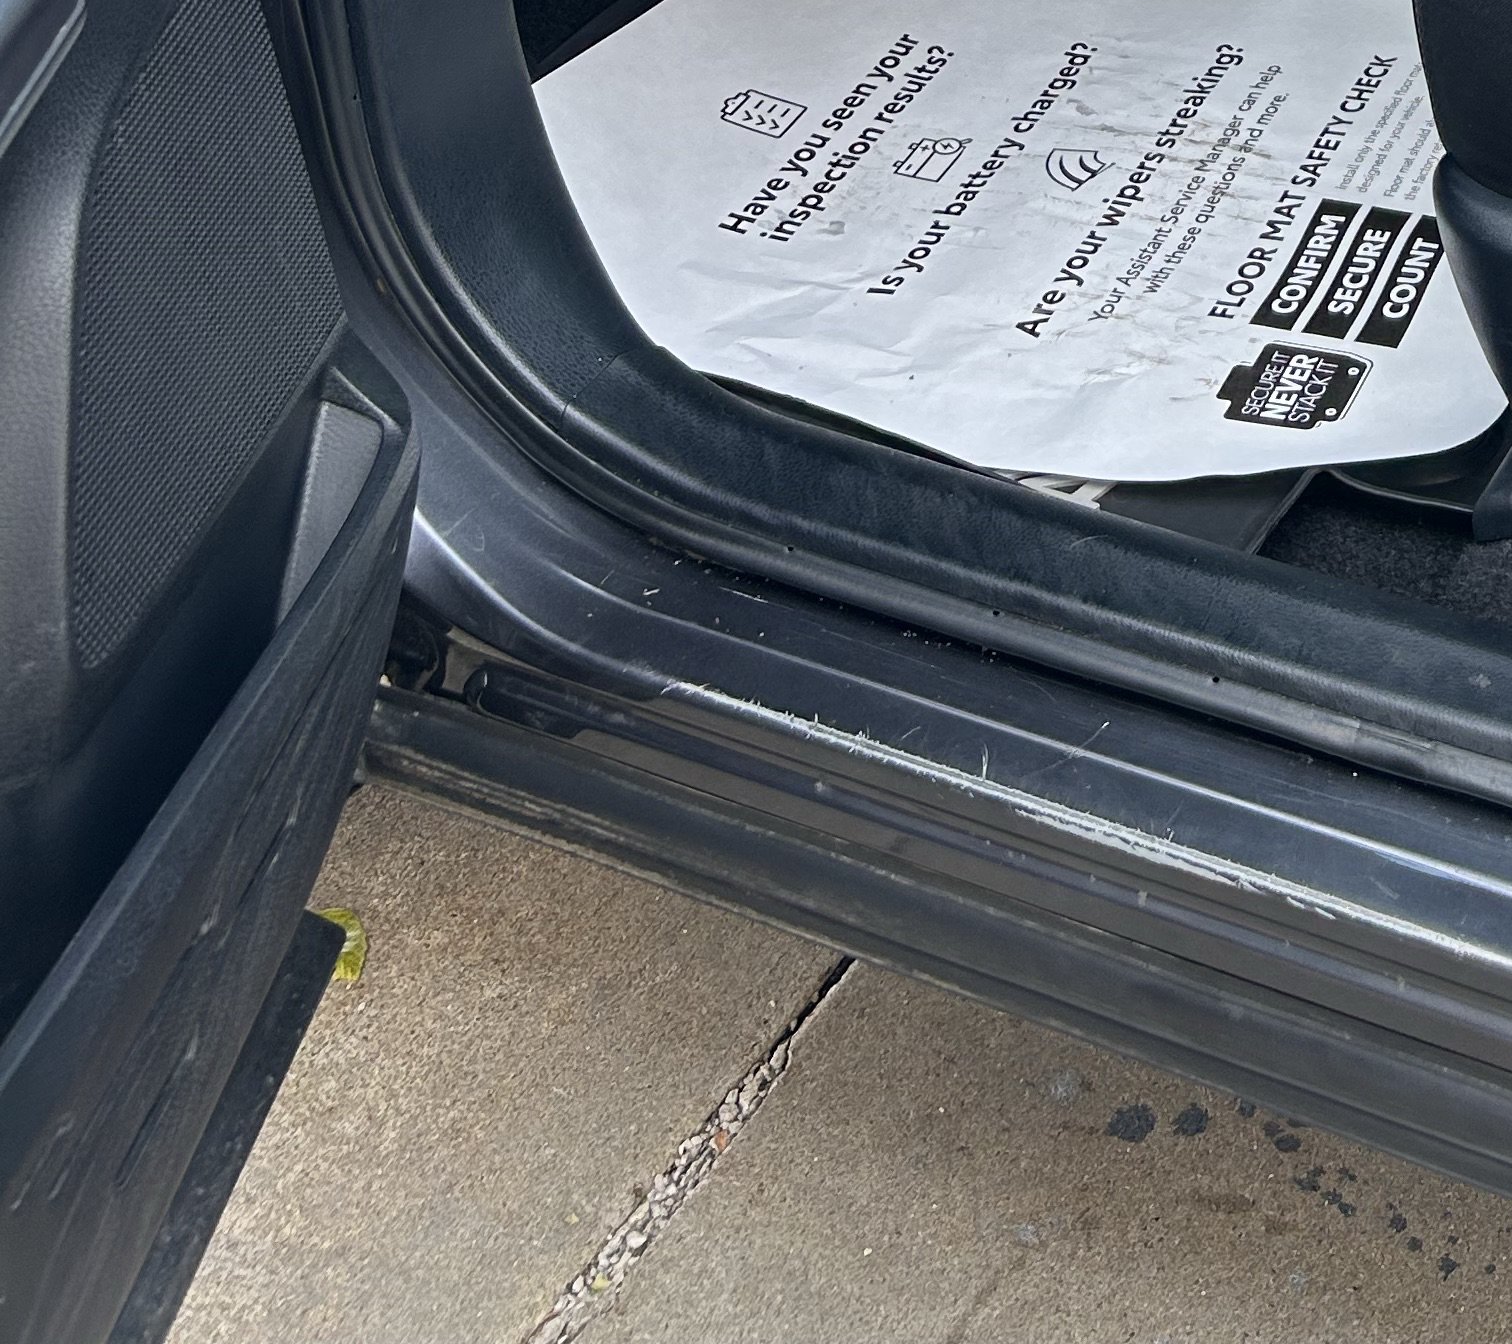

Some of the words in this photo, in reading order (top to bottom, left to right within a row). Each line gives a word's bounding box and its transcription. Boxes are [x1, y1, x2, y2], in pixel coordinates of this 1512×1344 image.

[1239, 91, 1262, 112] can
[1249, 64, 1283, 90] help
[718, 177, 791, 235] Have
[779, 133, 831, 178] you
[822, 81, 878, 132] seen
[866, 33, 920, 83] your
[759, 127, 886, 242] inspection
[874, 44, 955, 124] results?
[866, 274, 905, 296] Is
[894, 219, 951, 273] your
[932, 137, 1025, 216] battery
[1010, 42, 1099, 133] charged?
[1194, 114, 1244, 172] Manager
[1015, 288, 1067, 339] Are
[1054, 229, 1108, 288] your
[1096, 149, 1165, 227] wipers
[1155, 43, 1244, 149] streaking?
[1143, 267, 1175, 293] with
[1164, 226, 1201, 264] these
[1195, 156, 1246, 224] questions
[1238, 127, 1264, 153] and
[1256, 92, 1290, 125] more.
[1160, 175, 1205, 224] Service
[1208, 247, 1278, 319] FLOOR
[1259, 189, 1306, 242] MAT
[1291, 115, 1354, 188] SAFETY
[1340, 54, 1398, 113] CHECK
[1116, 227, 1172, 287] Assistant
[1271, 214, 1347, 314] CONFIRM
[1327, 228, 1392, 316] SECURE
[1382, 237, 1440, 319] COUNT
[1087, 287, 1125, 321] Your
[1241, 364, 1285, 416] SECURE
[1271, 350, 1291, 363] IT
[1260, 354, 1320, 421] NEVER
[1288, 375, 1333, 423] STACK
[1315, 358, 1339, 374] IT
